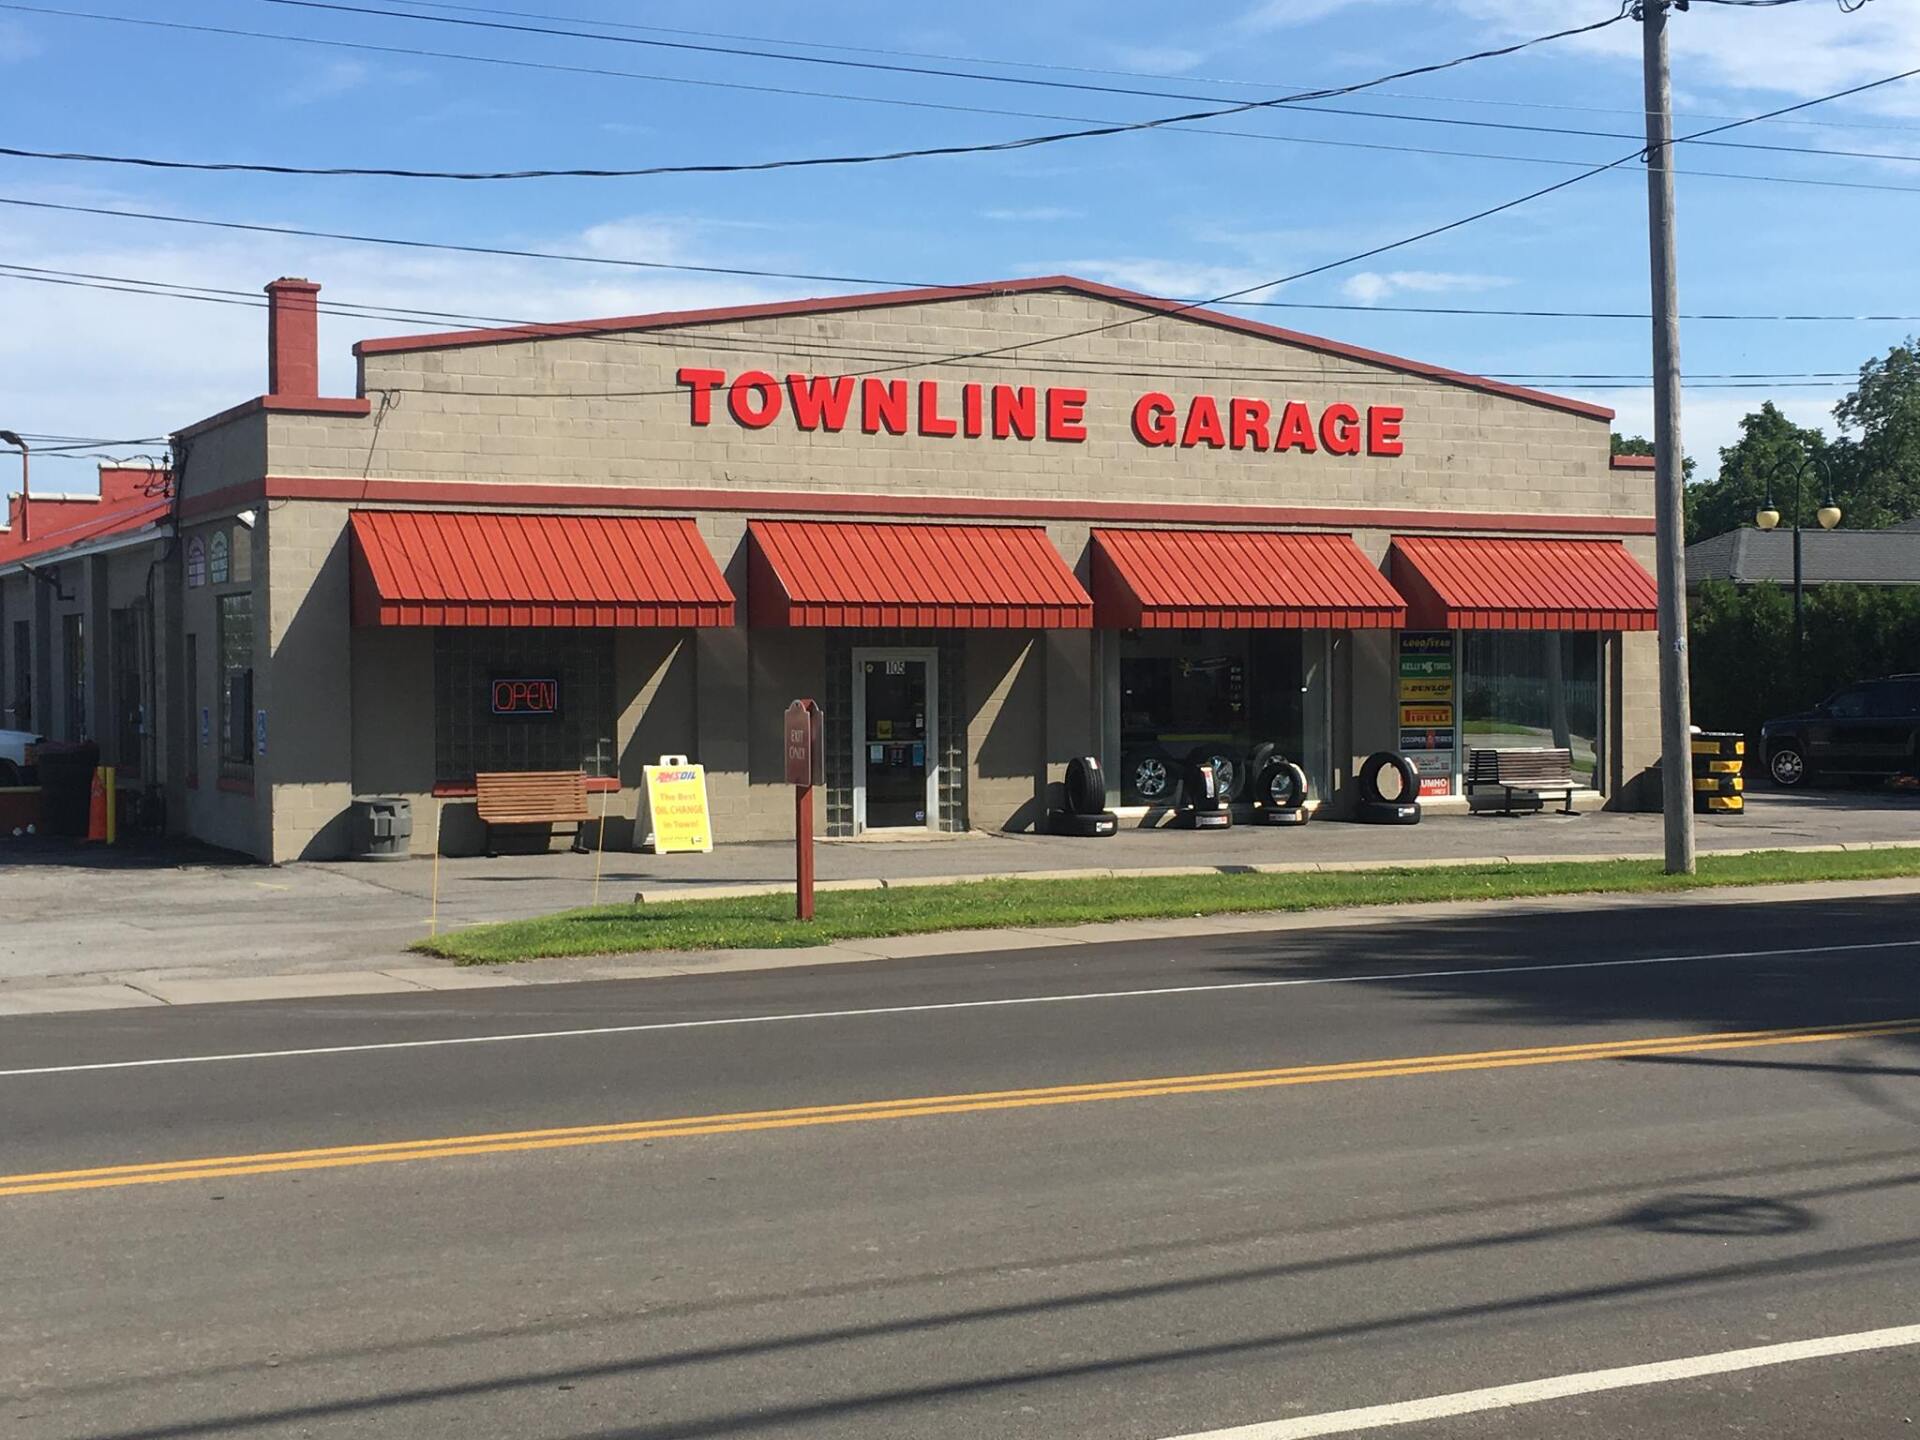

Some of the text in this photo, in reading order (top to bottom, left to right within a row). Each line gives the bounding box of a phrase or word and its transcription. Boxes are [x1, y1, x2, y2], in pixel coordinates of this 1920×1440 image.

[676, 366, 1404, 457] TOWNLINE GARAGE
[886, 661, 905, 675] 105
[1410, 684, 1451, 692] DUNLOP
[495, 682, 554, 710] OPEN
[1405, 710, 1449, 722] PIRELLI
[790, 729, 804, 743] EXIT
[1401, 735, 1453, 744] COOPER TIRES
[789, 745, 805, 760] ONLY
[656, 771, 696, 783] AMSOIL
[1420, 778, 1447, 788] UMHO
[660, 793, 696, 801] The Best
[655, 805, 704, 815] OIL CHANGE
